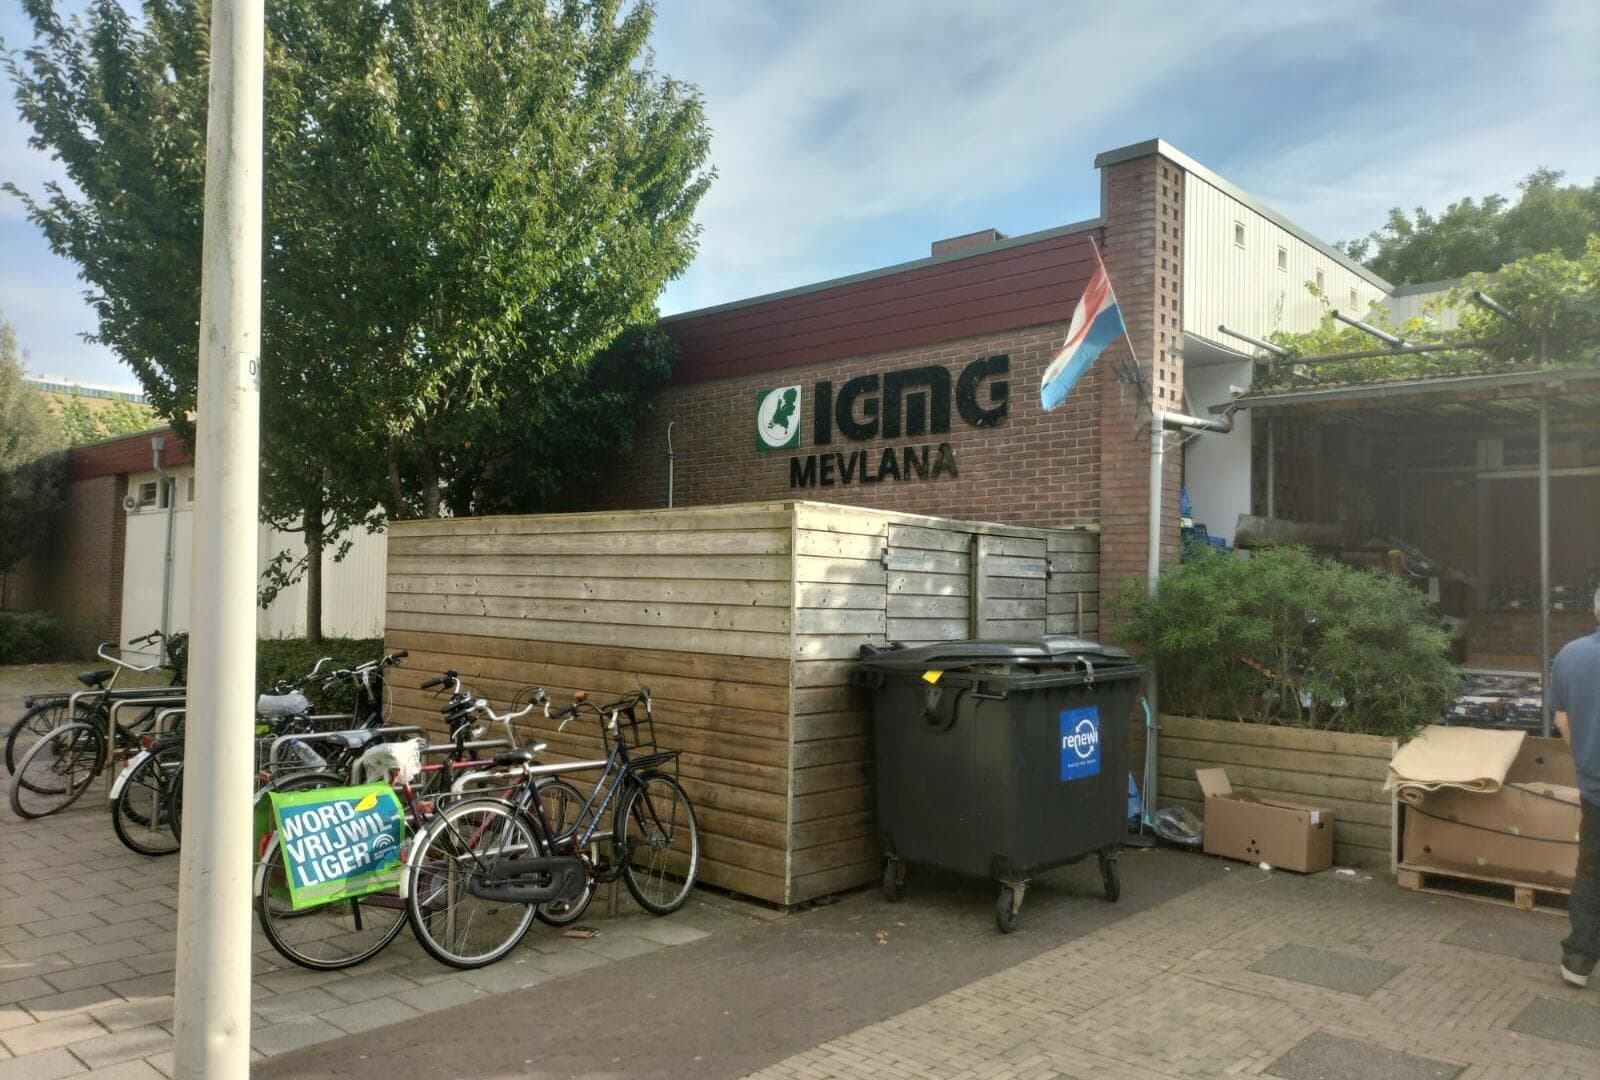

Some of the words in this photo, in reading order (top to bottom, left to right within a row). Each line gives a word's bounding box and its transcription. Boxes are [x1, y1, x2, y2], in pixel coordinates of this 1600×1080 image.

[814, 354, 1009, 445] IGMG
[790, 442, 958, 488] MEVLANA
[1062, 728, 1098, 748] renewi
[283, 801, 355, 841] WORD
[297, 842, 370, 886] LIGER
